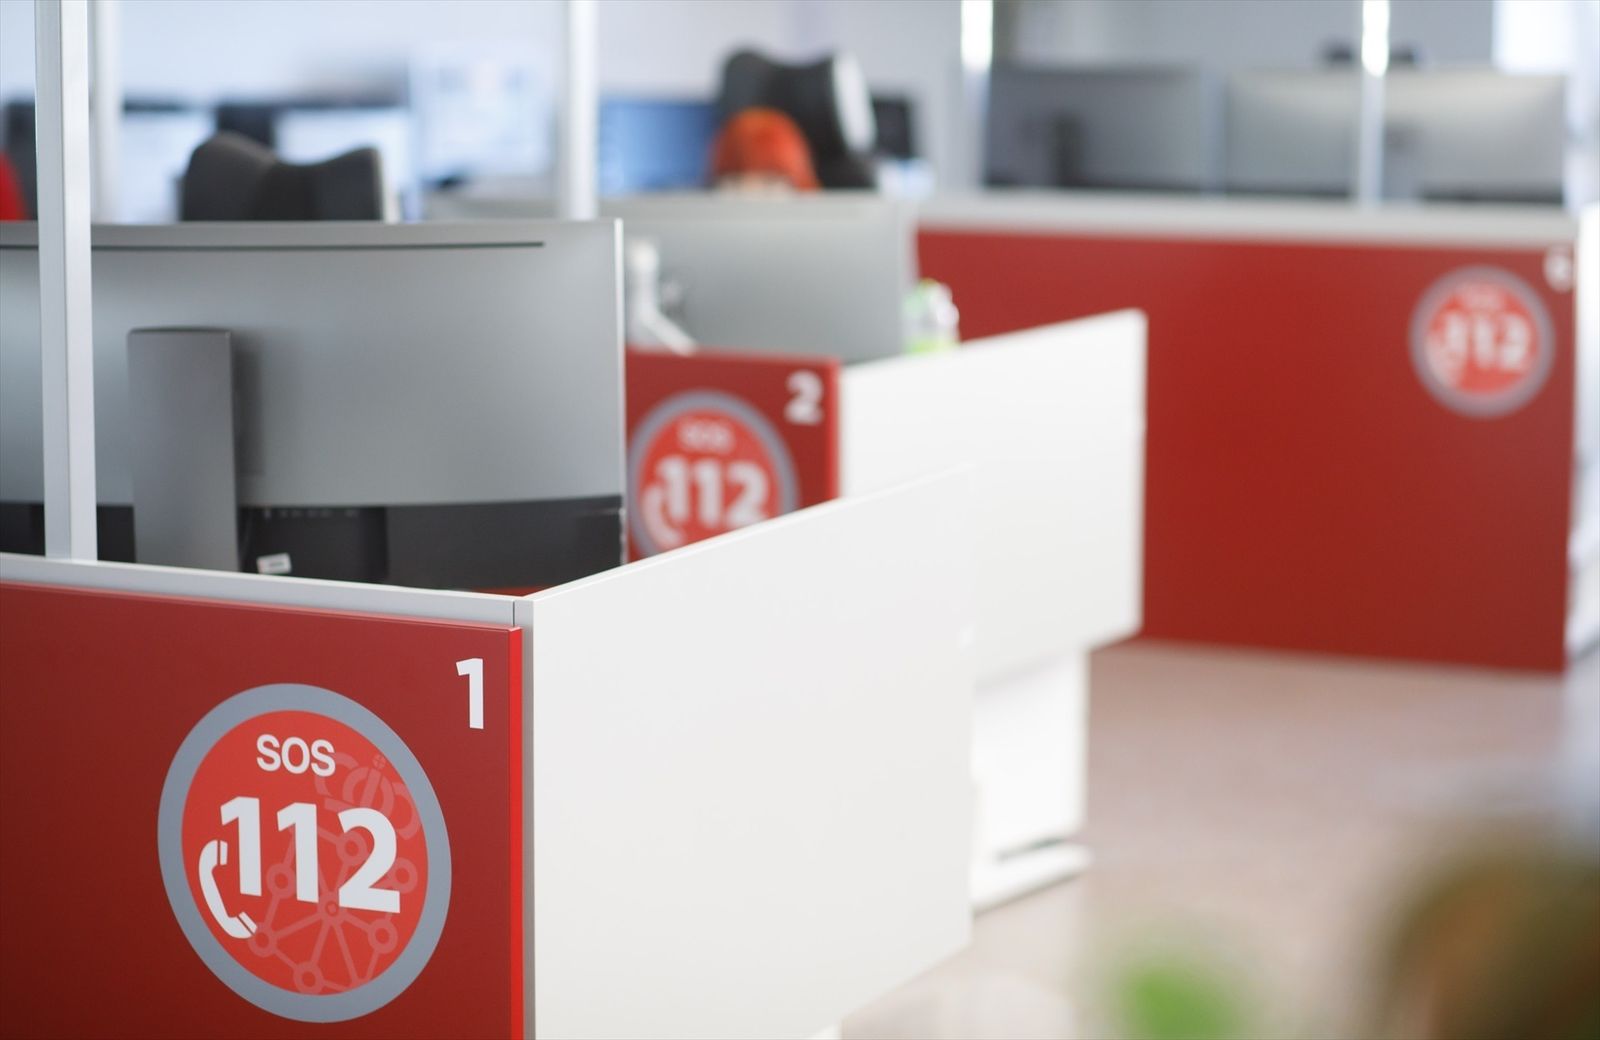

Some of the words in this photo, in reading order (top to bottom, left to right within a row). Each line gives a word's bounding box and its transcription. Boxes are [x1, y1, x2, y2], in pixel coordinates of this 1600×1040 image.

[784, 369, 824, 425] 2
[657, 456, 769, 529] 112
[456, 658, 485, 729] 1
[256, 734, 336, 777] SOS
[220, 796, 400, 913] 112
